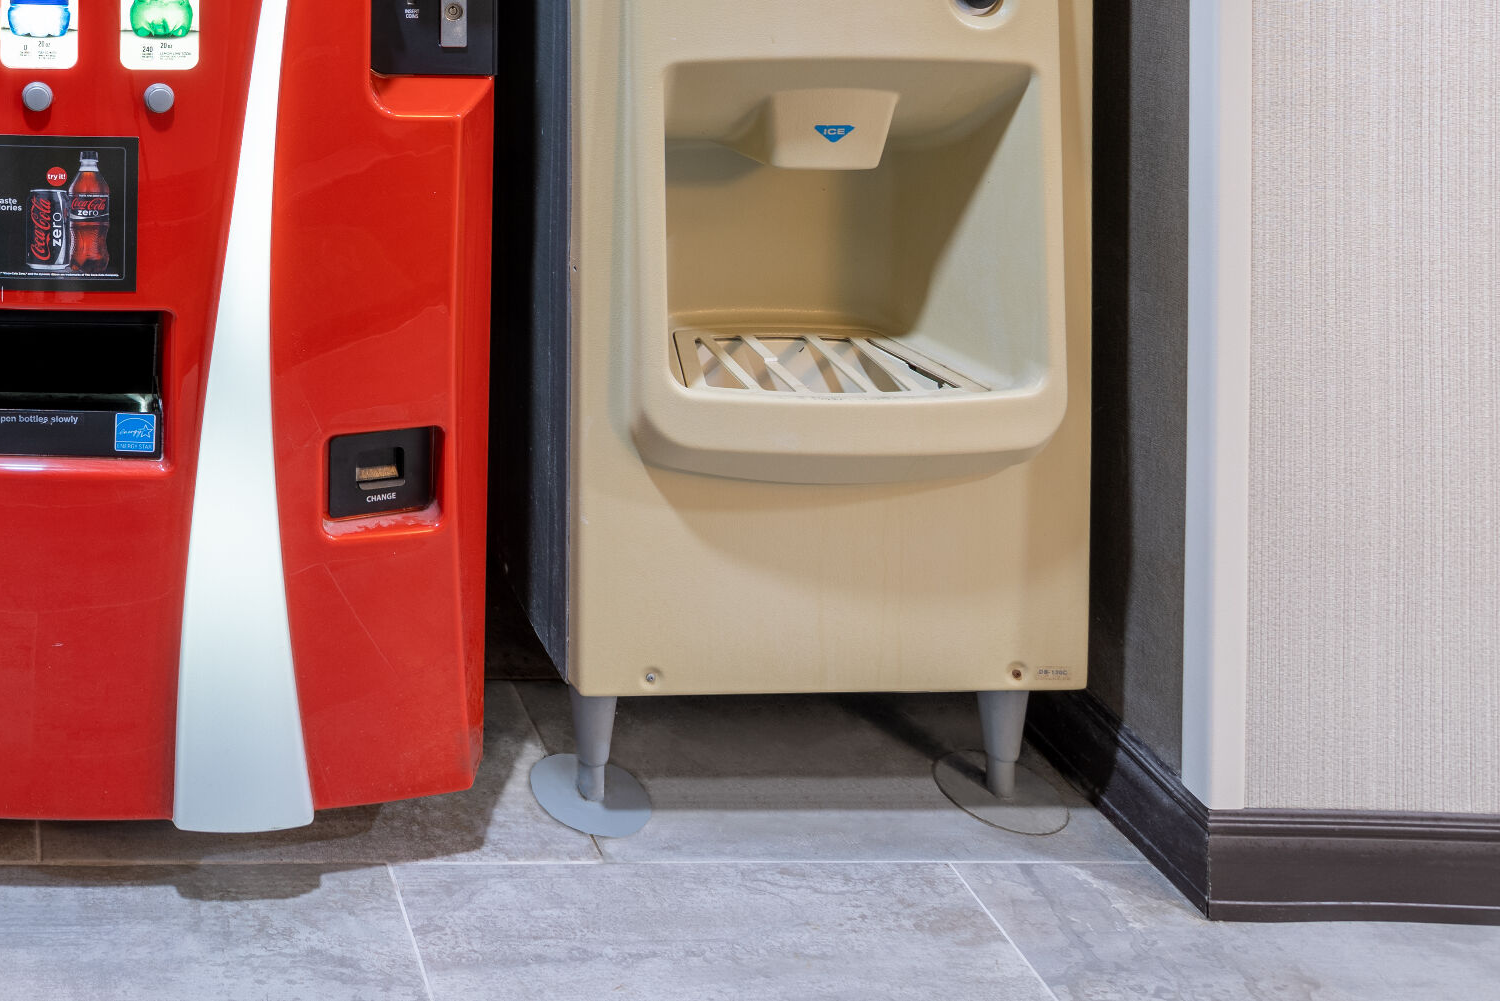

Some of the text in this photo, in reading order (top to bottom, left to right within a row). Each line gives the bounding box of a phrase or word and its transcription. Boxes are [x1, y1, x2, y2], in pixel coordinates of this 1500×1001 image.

[142, 45, 154, 53] 240
[47, 173, 58, 181] try
[71, 197, 107, 210] Coca-Cola
[77, 209, 99, 217] zero
[30, 196, 51, 261] Coca-Cola
[52, 212, 62, 247] zero
[19, 414, 49, 424] bottles
[50, 415, 79, 425] slowly
[366, 492, 397, 503] CHANGE
